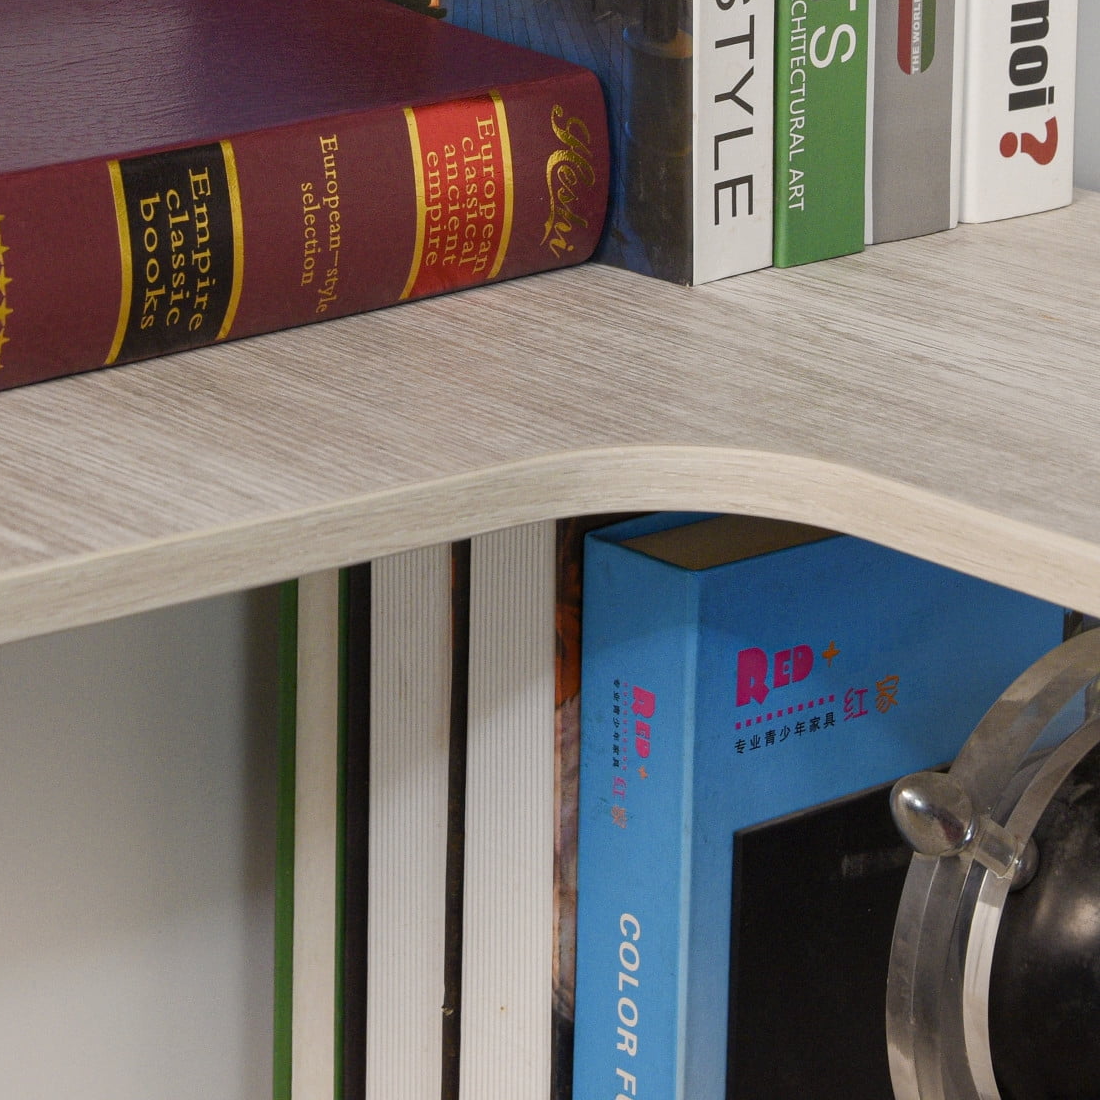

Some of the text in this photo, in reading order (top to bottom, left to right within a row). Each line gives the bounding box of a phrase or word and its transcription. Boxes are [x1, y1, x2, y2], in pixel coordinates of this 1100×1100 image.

[910, 45, 920, 74] THE
[188, 167, 216, 332] Empire
[301, 182, 322, 287] selection
[425, 151, 442, 266] empire
[442, 144, 461, 266] ancient
[459, 136, 482, 267] classical
[473, 115, 497, 275] European
[788, 168, 805, 211] ART
[140, 192, 166, 330] books
[166, 188, 190, 327] classic
[734, 711, 836, 754] 专业青少年家具
[615, 912, 641, 1100] COLOR F
